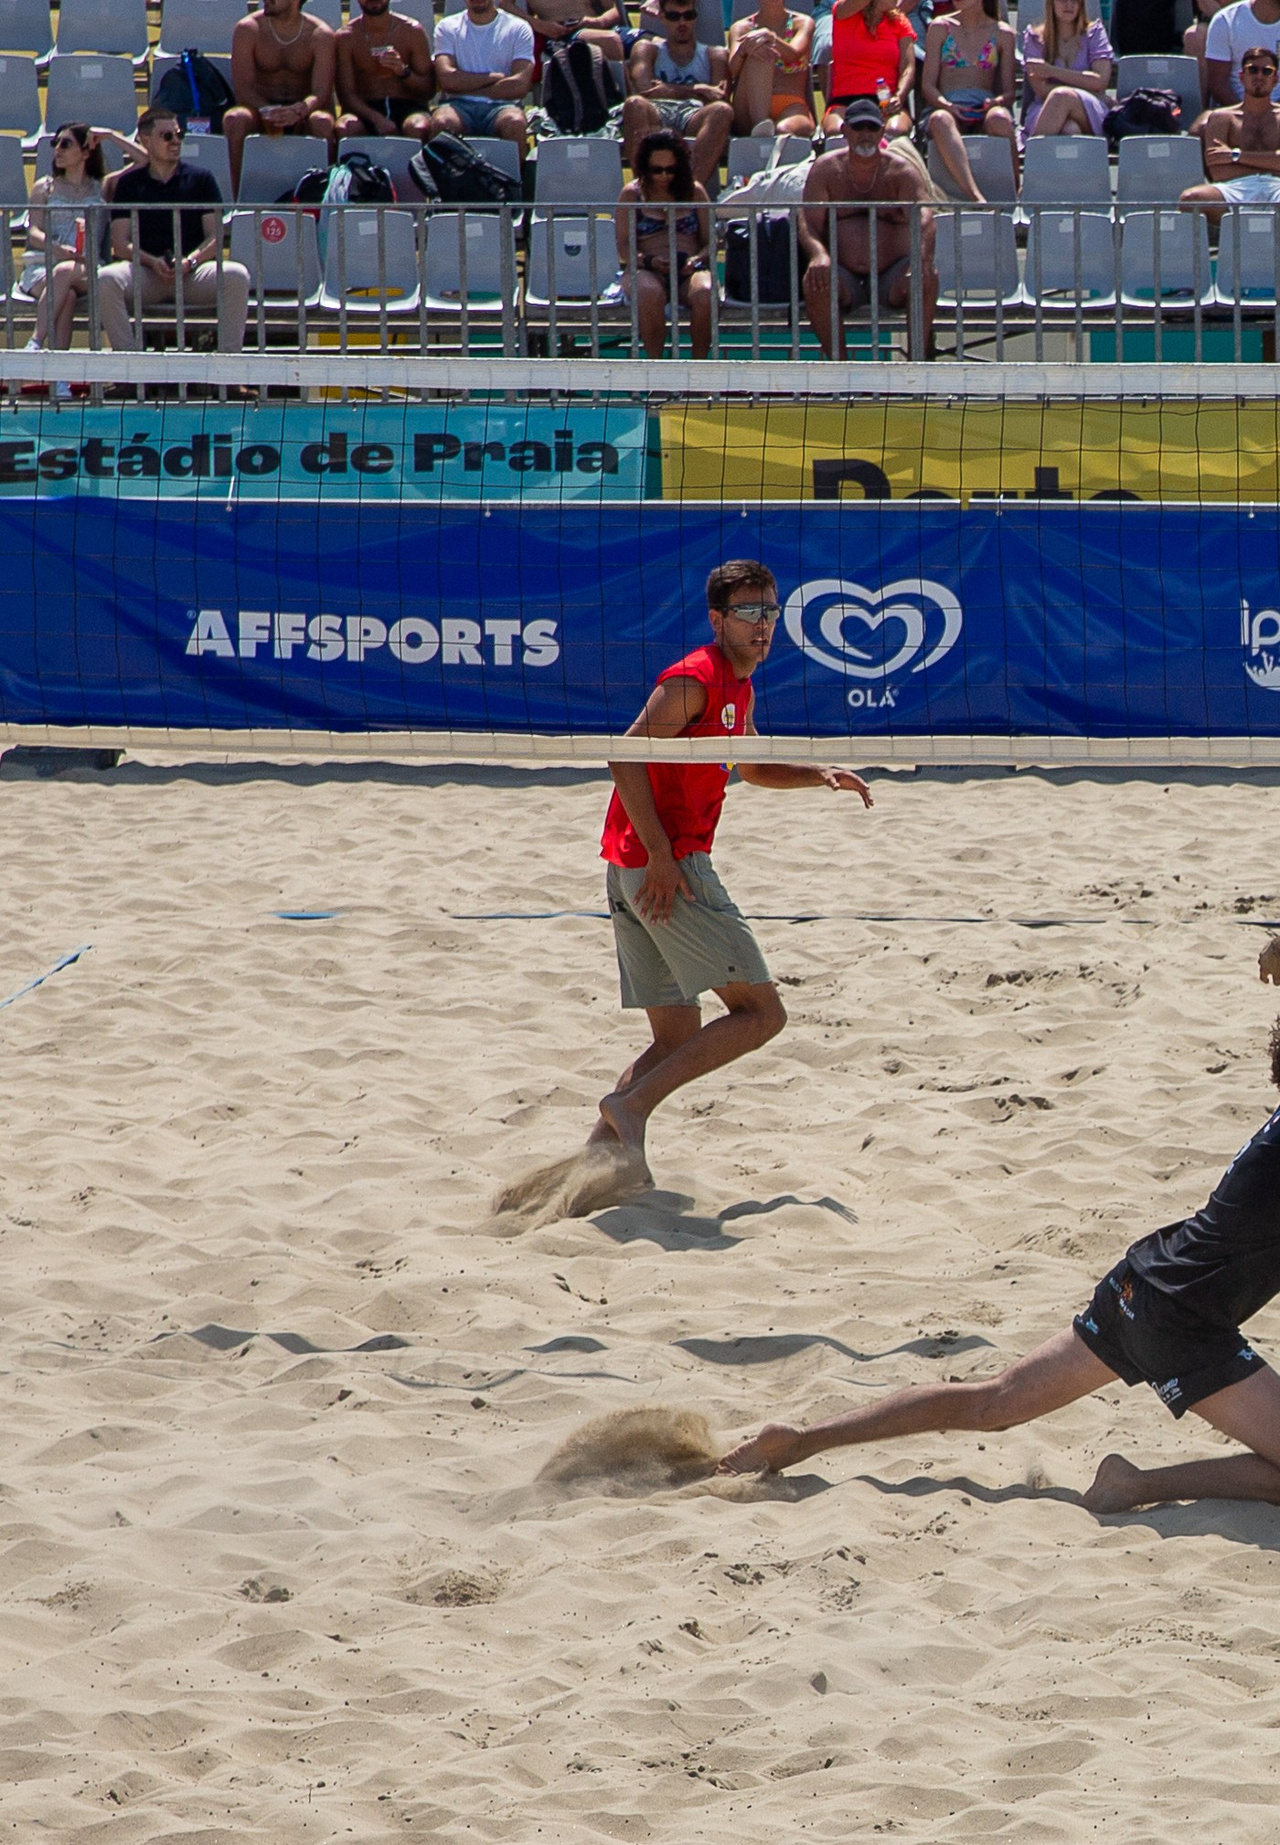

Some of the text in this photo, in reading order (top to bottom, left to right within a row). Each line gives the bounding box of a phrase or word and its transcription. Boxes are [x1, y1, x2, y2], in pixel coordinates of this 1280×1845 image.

[0, 430, 619, 483] Estádio de Praia
[185, 609, 560, 667] AFFSPORTS
[848, 683, 896, 708] OLÁ
